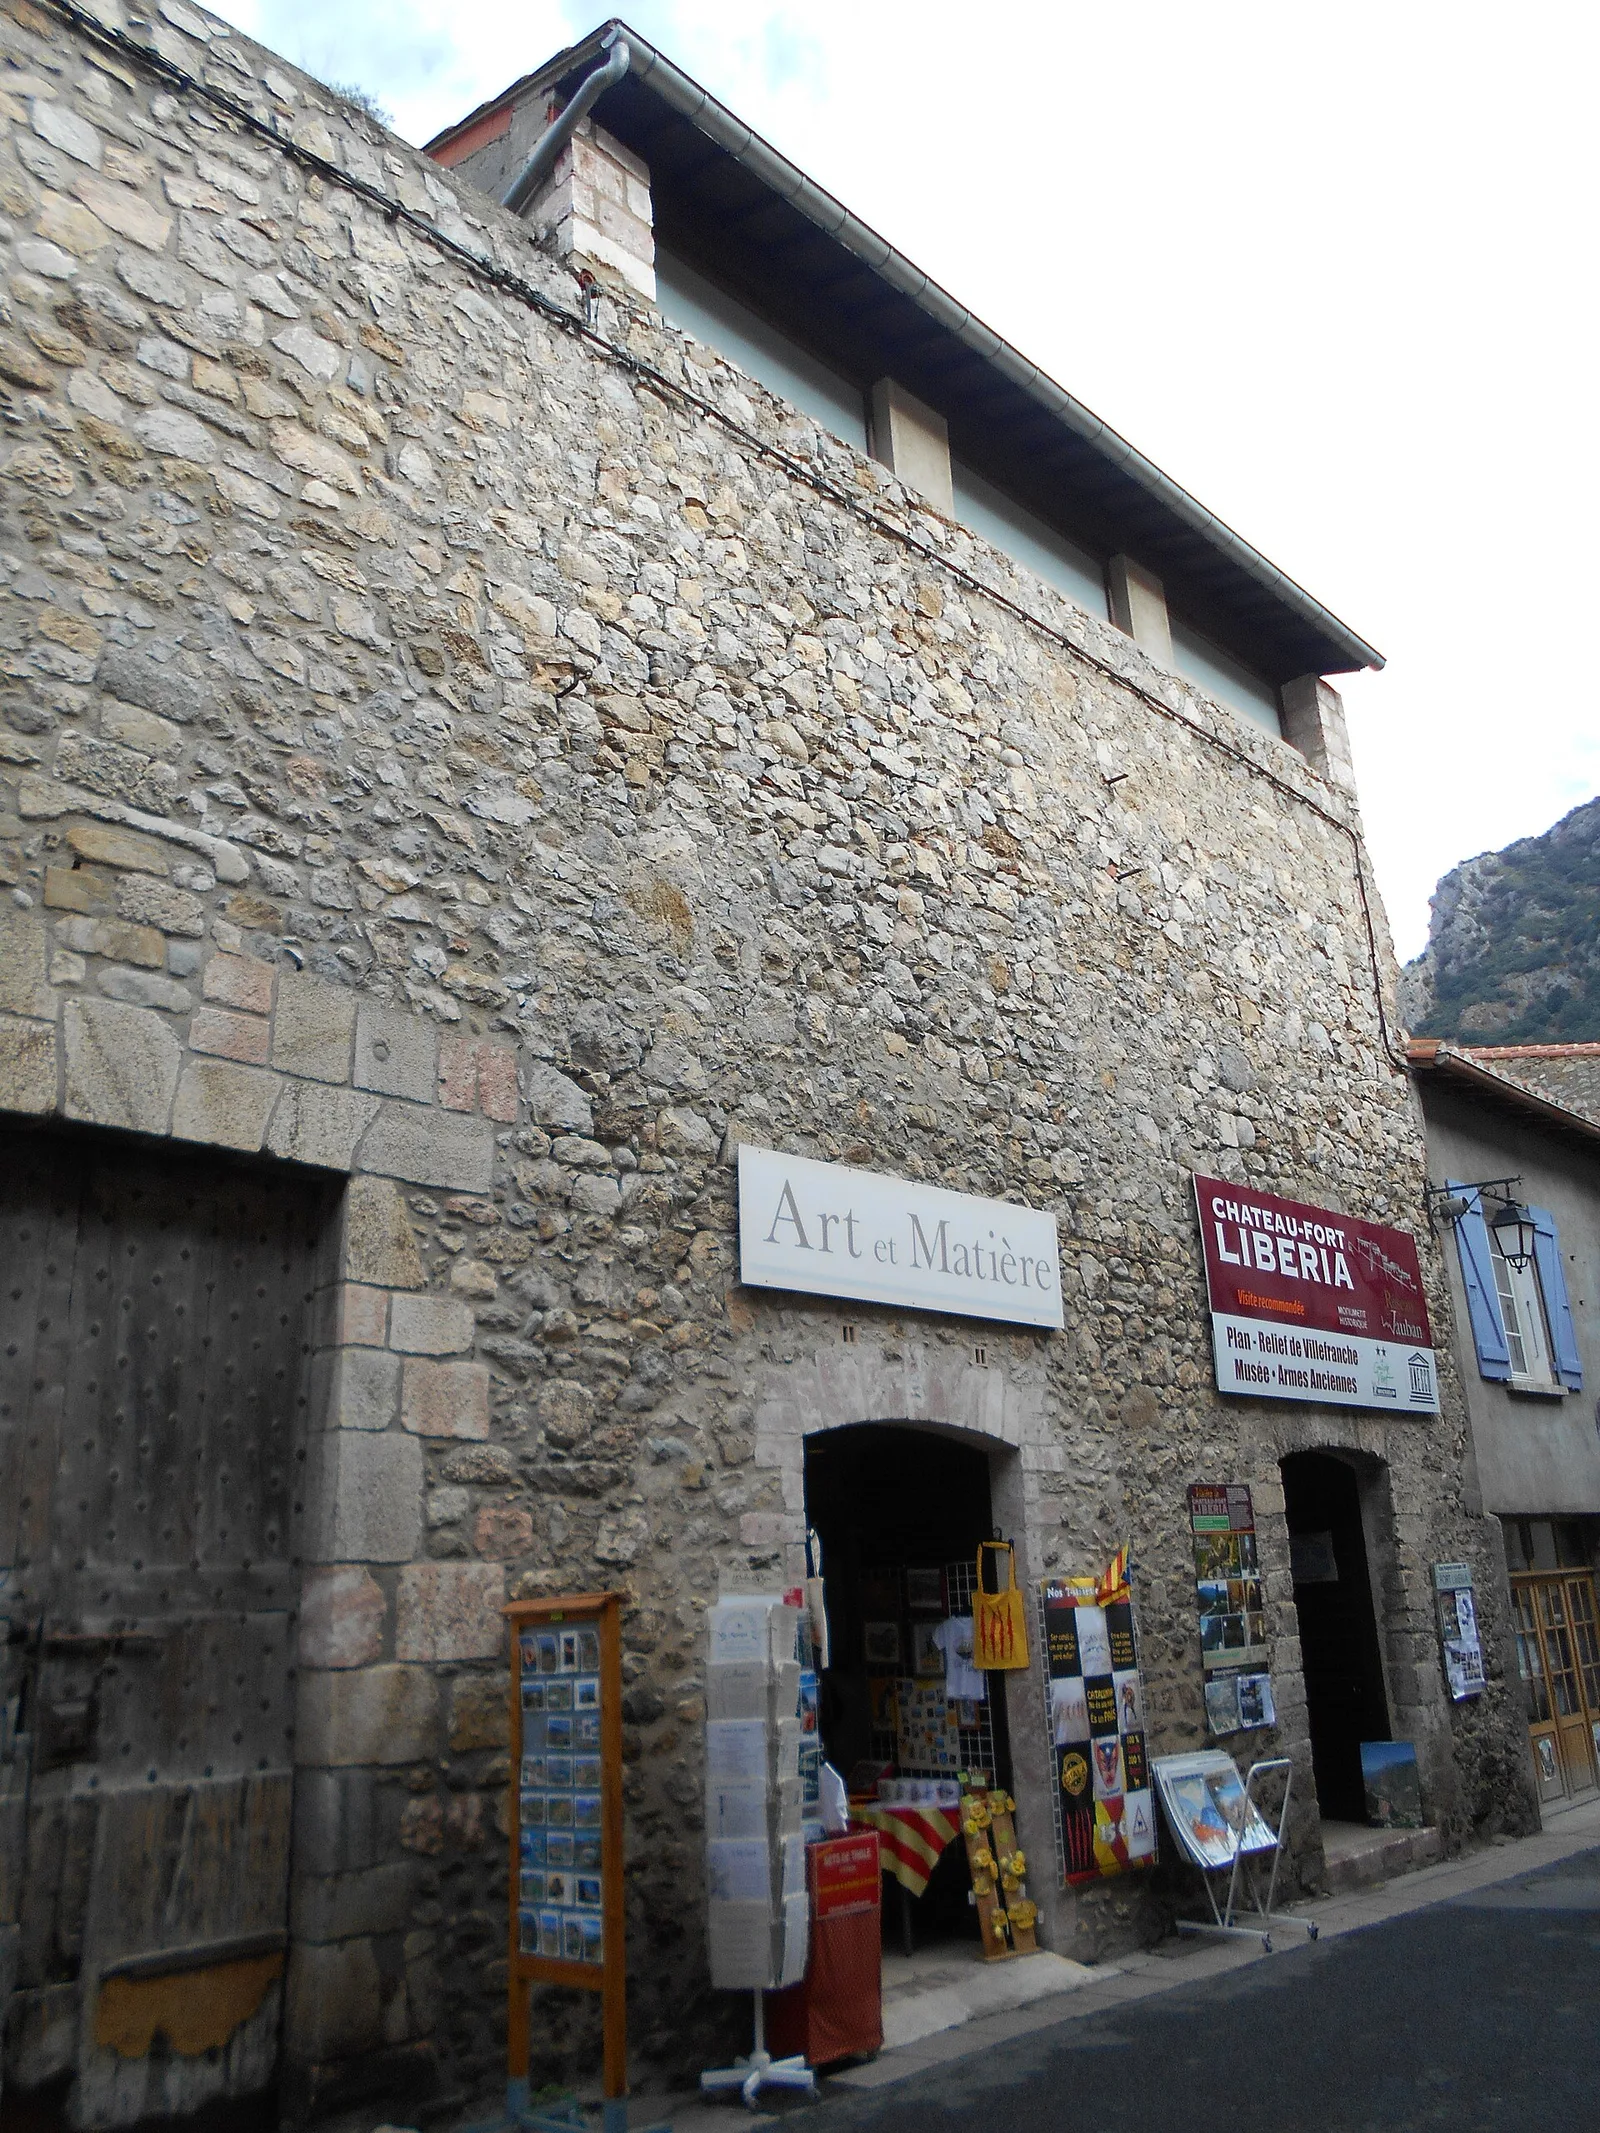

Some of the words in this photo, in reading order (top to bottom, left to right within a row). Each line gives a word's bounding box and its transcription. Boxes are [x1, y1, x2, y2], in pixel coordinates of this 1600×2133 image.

[763, 1178, 862, 1259] Art
[874, 1237, 898, 1265] et
[907, 1212, 1052, 1292] Matière
[1211, 1197, 1345, 1250] CHATEAU-FORT
[1213, 1221, 1355, 1290] LIBERIA
[1237, 1289, 1258, 1306] Visite
[1257, 1296, 1305, 1317] recommandée
[1226, 1326, 1251, 1348] Plan
[1258, 1331, 1288, 1354] Relief
[1289, 1338, 1301, 1357] de
[1302, 1338, 1359, 1366] Villefranche
[1234, 1358, 1270, 1384] Musée
[1278, 1364, 1308, 1388] Armes
[1310, 1368, 1358, 1394] Anciennes
[1046, 1587, 1063, 1598] Nos
